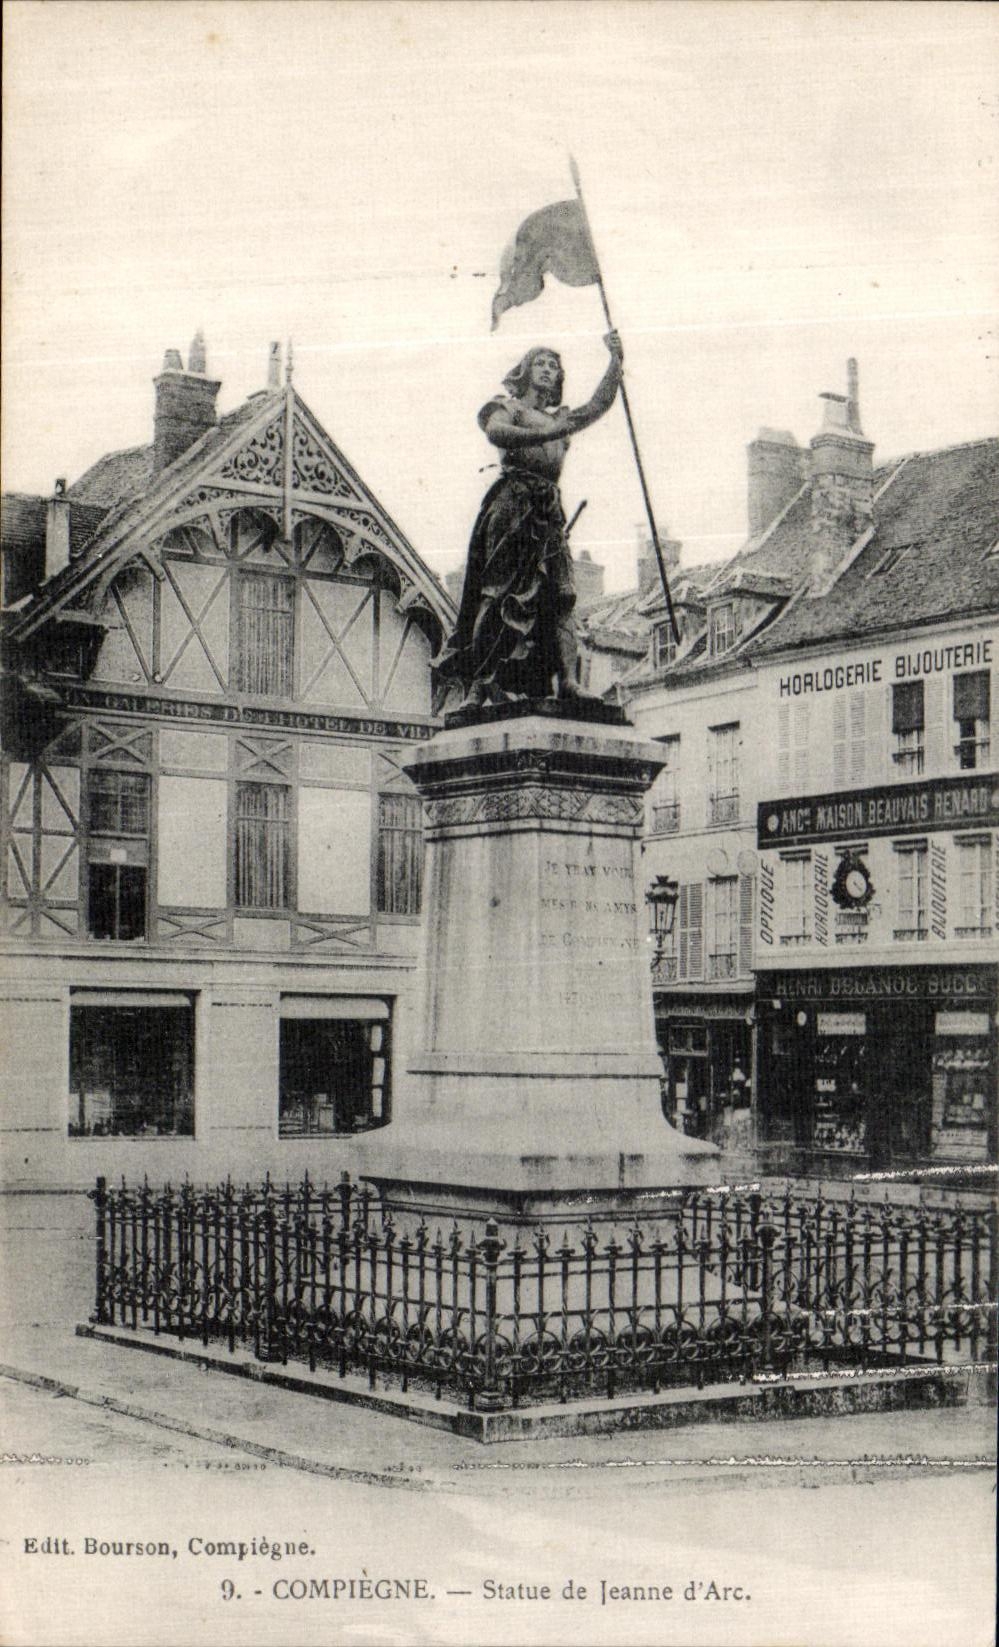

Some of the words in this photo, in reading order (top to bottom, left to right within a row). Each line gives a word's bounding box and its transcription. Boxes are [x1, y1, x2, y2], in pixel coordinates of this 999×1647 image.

[779, 659, 882, 698] HORLOGERIE
[895, 639, 993, 679] BIJOUTERIE
[105, 695, 213, 720] GALERIES
[223, 708, 255, 722] DE
[360, 722, 386, 735] DE
[397, 724, 434, 739] VILL
[816, 802, 862, 831] MAISON
[868, 793, 928, 825] BEAUVAIS
[934, 787, 988, 817] RENARD
[760, 858, 775, 946] OPTIQUE
[814, 850, 829, 947] HORLOGERIE
[931, 840, 946, 940] BIJOUTERIE
